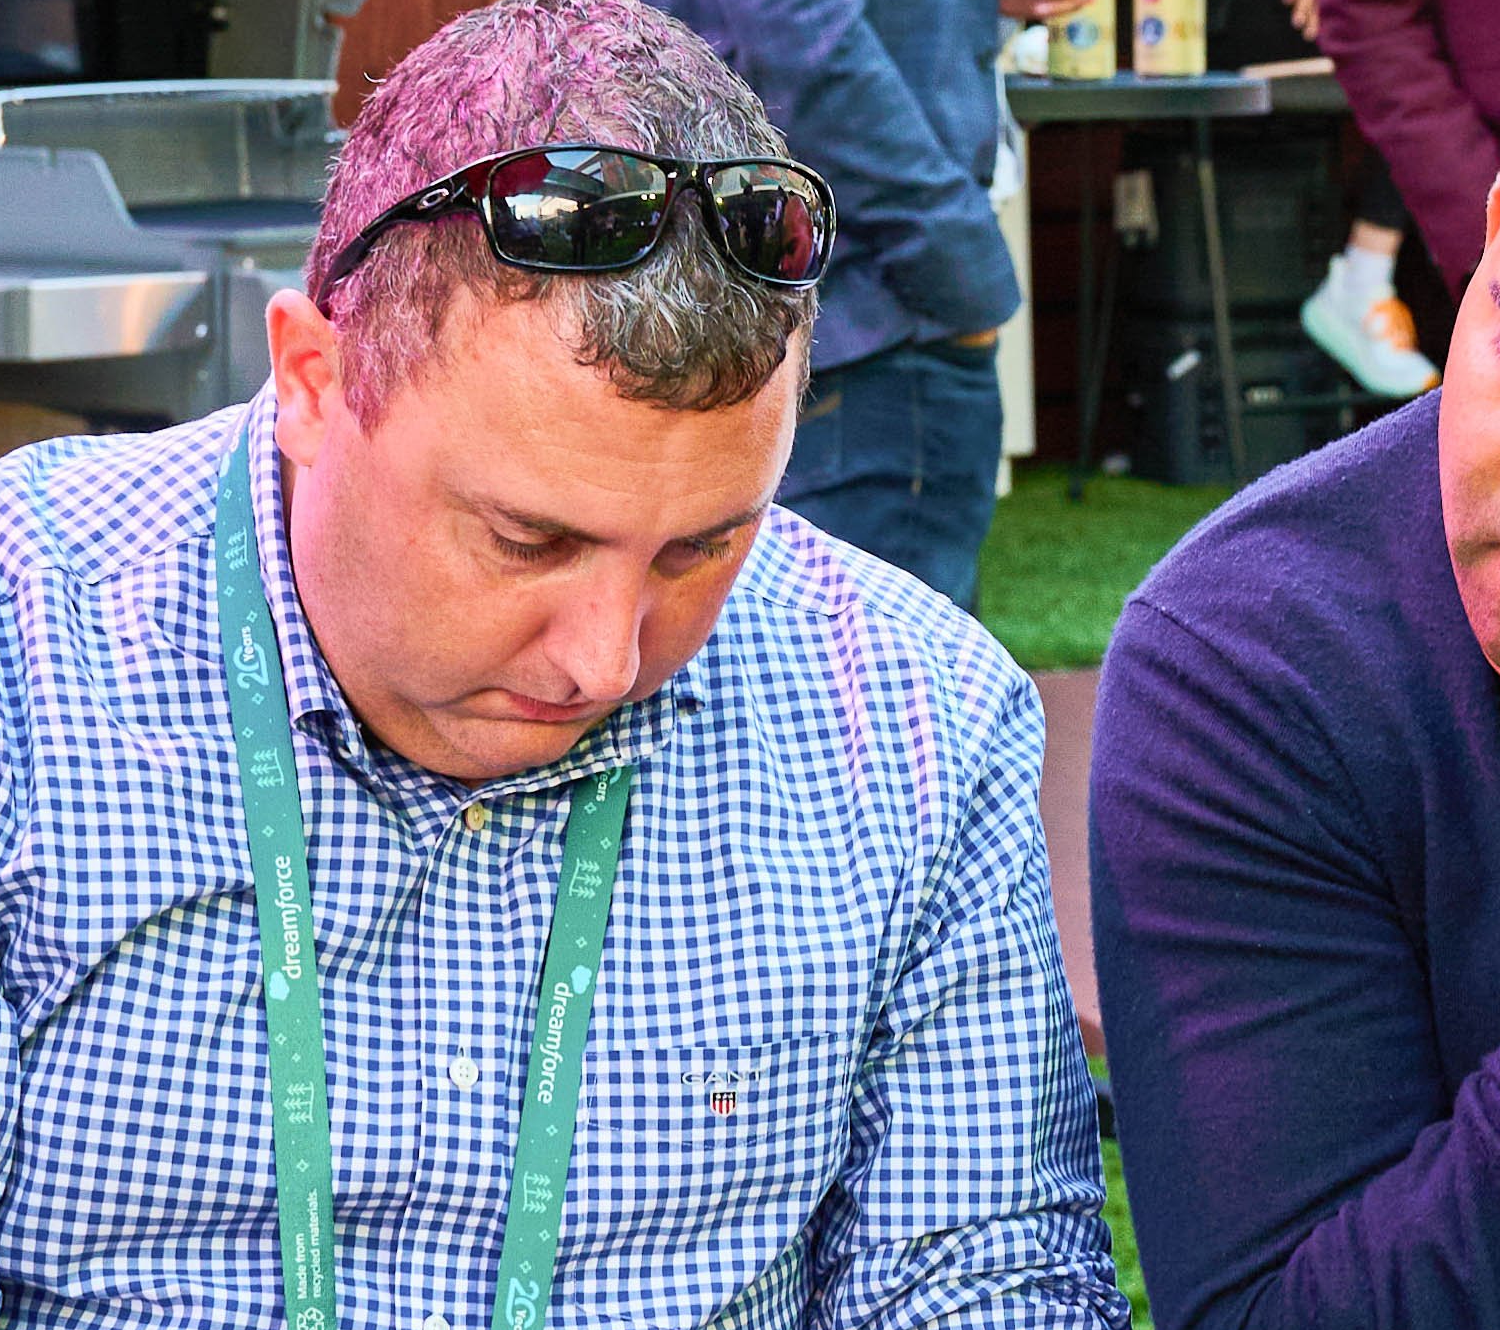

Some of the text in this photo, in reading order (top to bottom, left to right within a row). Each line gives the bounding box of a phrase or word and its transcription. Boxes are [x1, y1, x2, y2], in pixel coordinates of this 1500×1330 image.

[241, 625, 255, 662] Years
[595, 773, 609, 803] ears
[276, 855, 305, 982] dreamforce
[534, 981, 571, 1107] dreamforce
[681, 1067, 766, 1087] GANT
[295, 1232, 308, 1300] Made from
[309, 1248, 325, 1299] recycled
